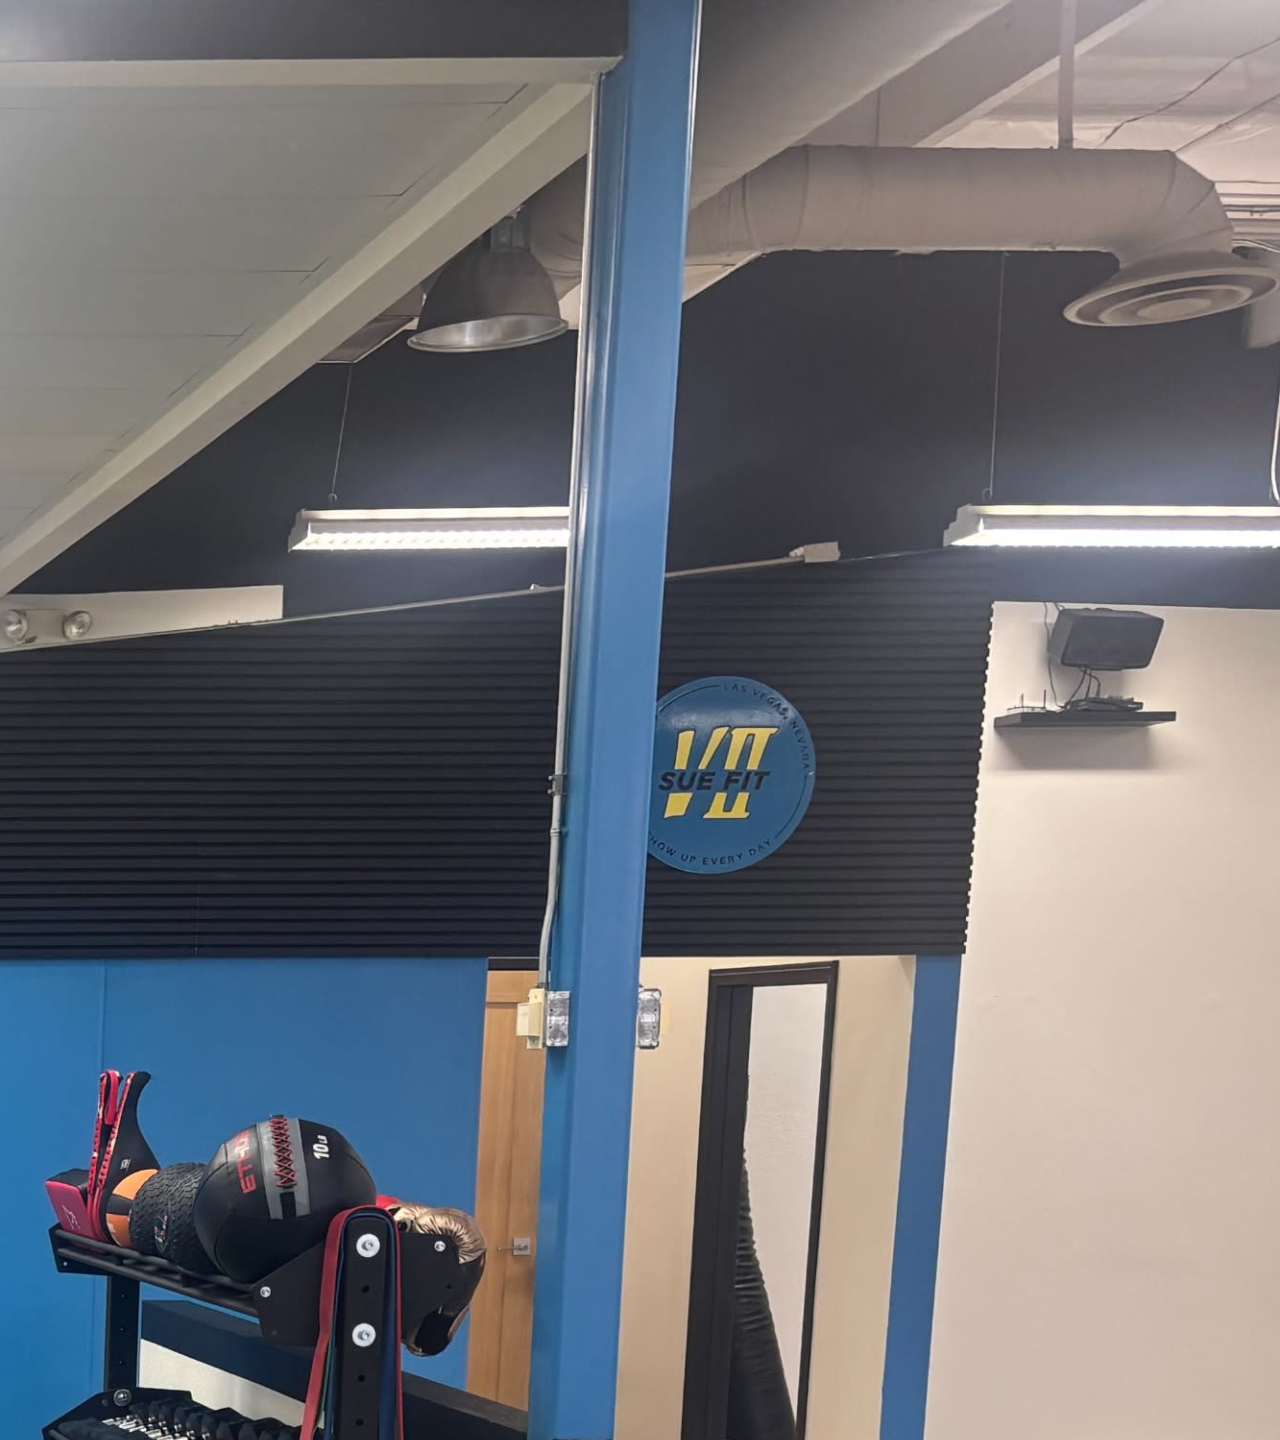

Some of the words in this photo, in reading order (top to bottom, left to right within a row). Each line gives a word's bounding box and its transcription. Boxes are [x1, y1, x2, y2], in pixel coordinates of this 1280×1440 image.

[658, 771, 716, 791] SUE
[723, 771, 771, 791] FIT
[648, 836, 677, 857] HOW
